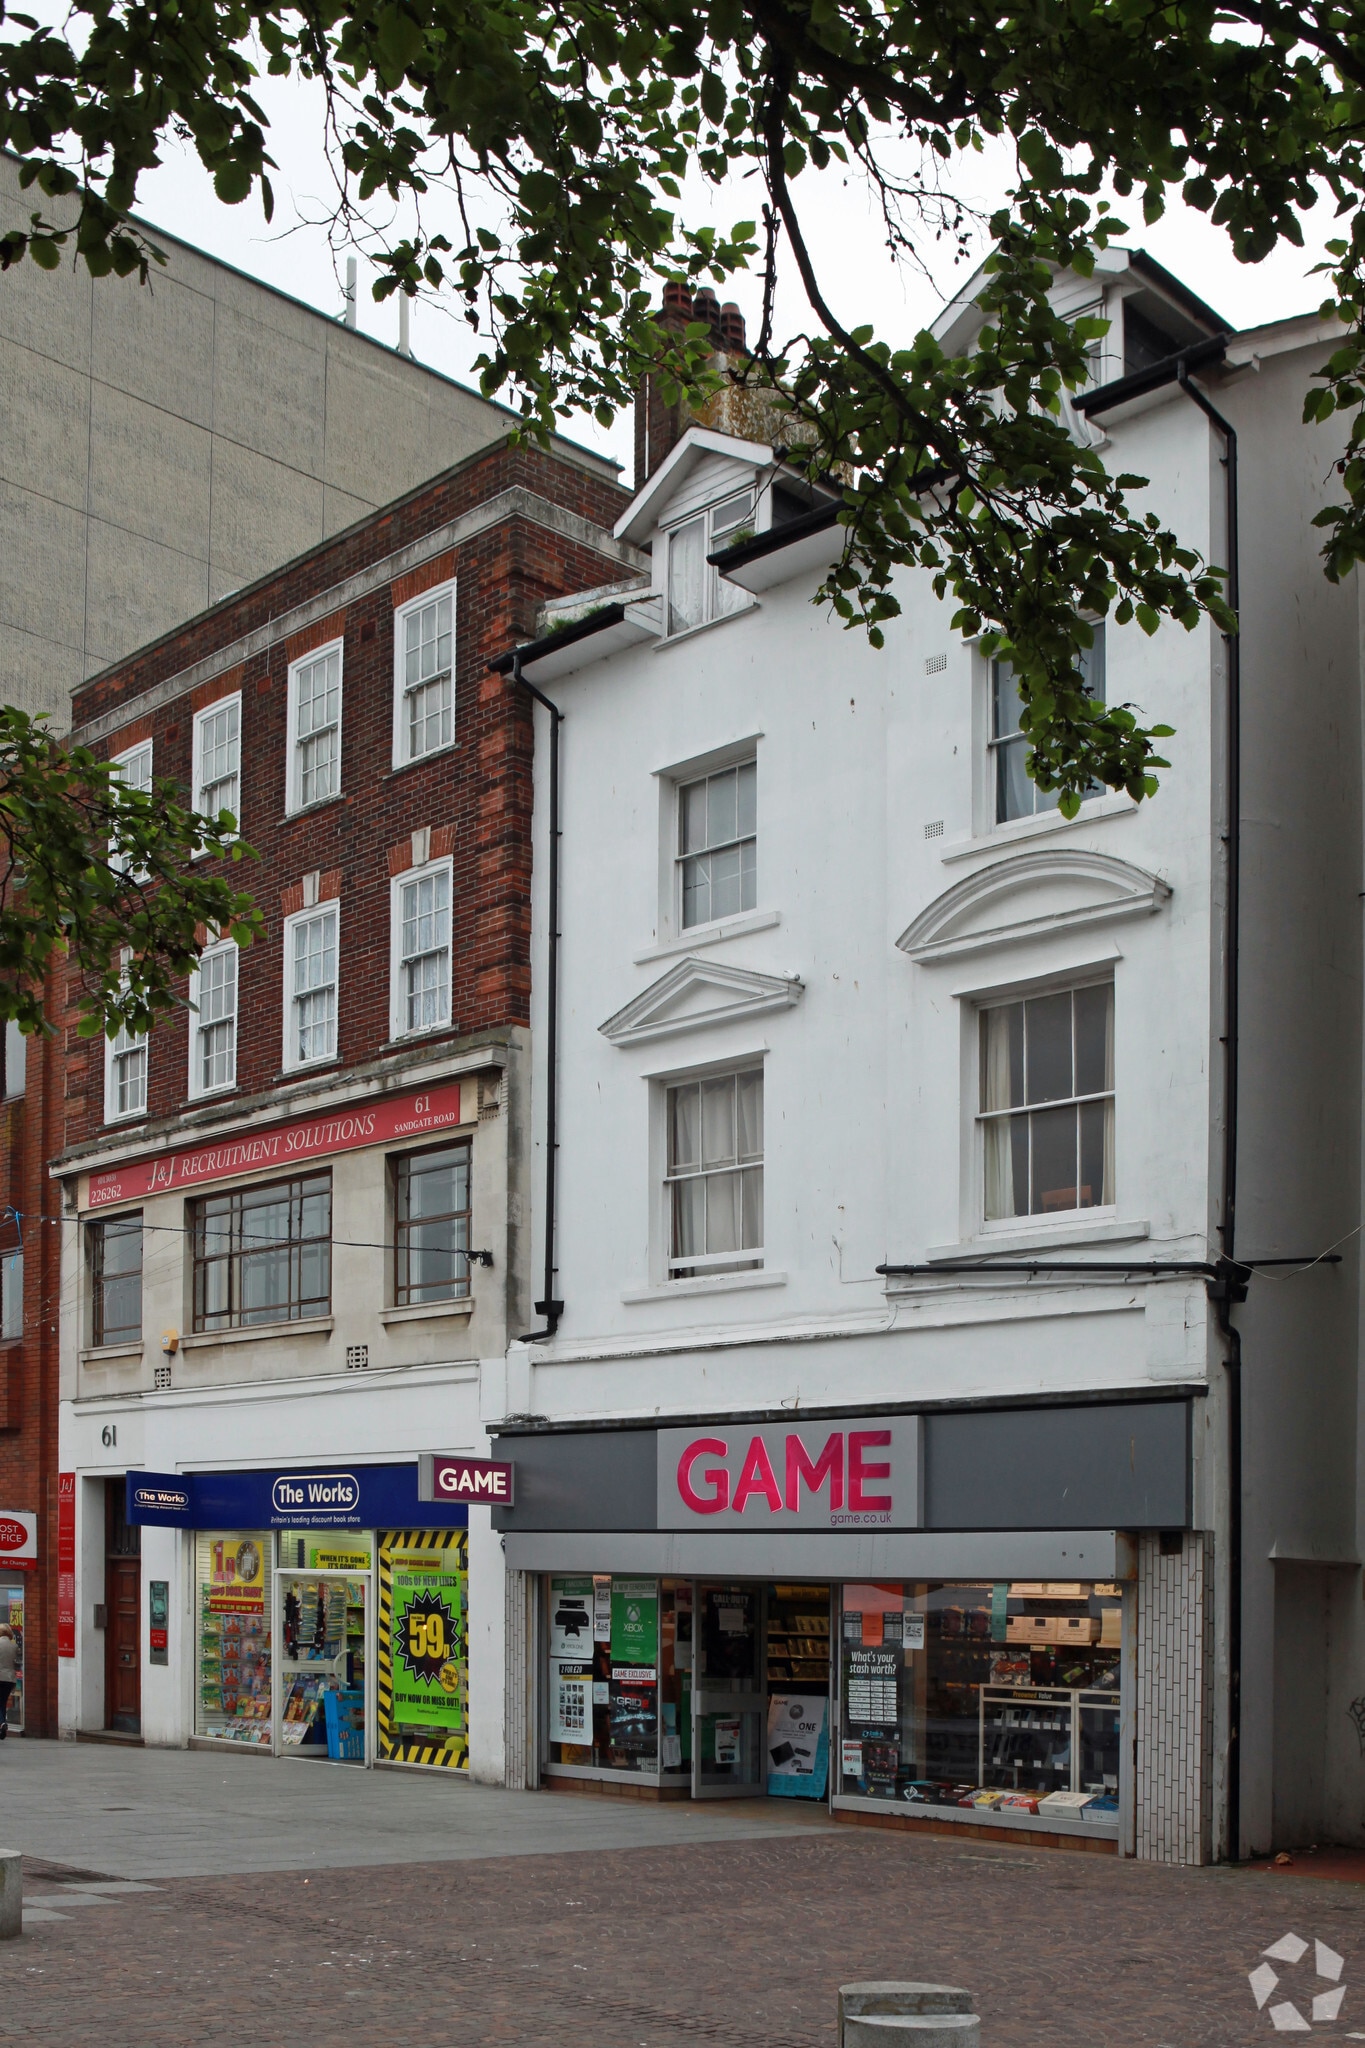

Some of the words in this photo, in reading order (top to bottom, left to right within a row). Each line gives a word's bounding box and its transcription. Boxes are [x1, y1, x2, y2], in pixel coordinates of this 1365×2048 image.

[415, 1096, 430, 1114] 61
[394, 1116, 432, 1134] SANDGATE
[434, 1112, 455, 1125] ROAD
[147, 1156, 176, 1190] J&J
[180, 1135, 281, 1177] RECRUITMENT
[285, 1113, 375, 1153] SOLUTIONS
[91, 1185, 121, 1204] 226262
[101, 1424, 117, 1447] 61
[677, 1429, 892, 1514] GAME
[438, 1467, 506, 1495] GAME
[138, 1491, 155, 1501] The
[158, 1493, 185, 1503] Works
[278, 1483, 304, 1503] The
[308, 1481, 353, 1503] Works
[291, 1515, 310, 1525] leading
[311, 1515, 332, 1523] discount
[333, 1515, 346, 1523] book
[830, 1512, 892, 1526] game.co.uk
[319, 1554, 338, 1562] WHEN
[338, 1555, 350, 1563] IT'S
[397, 1575, 413, 1586] 100s
[414, 1576, 421, 1586] OF
[422, 1576, 437, 1587] NEW
[440, 1576, 457, 1587] LINES
[623, 1623, 644, 1633] XBOX
[409, 1613, 450, 1659] 59p
[851, 1651, 876, 1663] What's
[876, 1653, 895, 1665] your
[561, 1665, 565, 1674] 2
[564, 1665, 573, 1674] FOR
[573, 1665, 583, 1674] £20
[613, 1670, 628, 1678] GAME
[628, 1670, 653, 1679] EXCLUSIVE
[849, 1662, 870, 1674] stash
[870, 1663, 897, 1675] worth?
[395, 1692, 407, 1703] BUY
[407, 1694, 421, 1704] NOW
[422, 1695, 430, 1704] OR
[431, 1696, 446, 1705] MISS
[446, 1697, 460, 1708] OUT!
[616, 1696, 642, 1707] GRID
[1013, 1690, 1037, 1699] Preowned
[1038, 1692, 1053, 1700] Value
[798, 1722, 817, 1732] ONE
